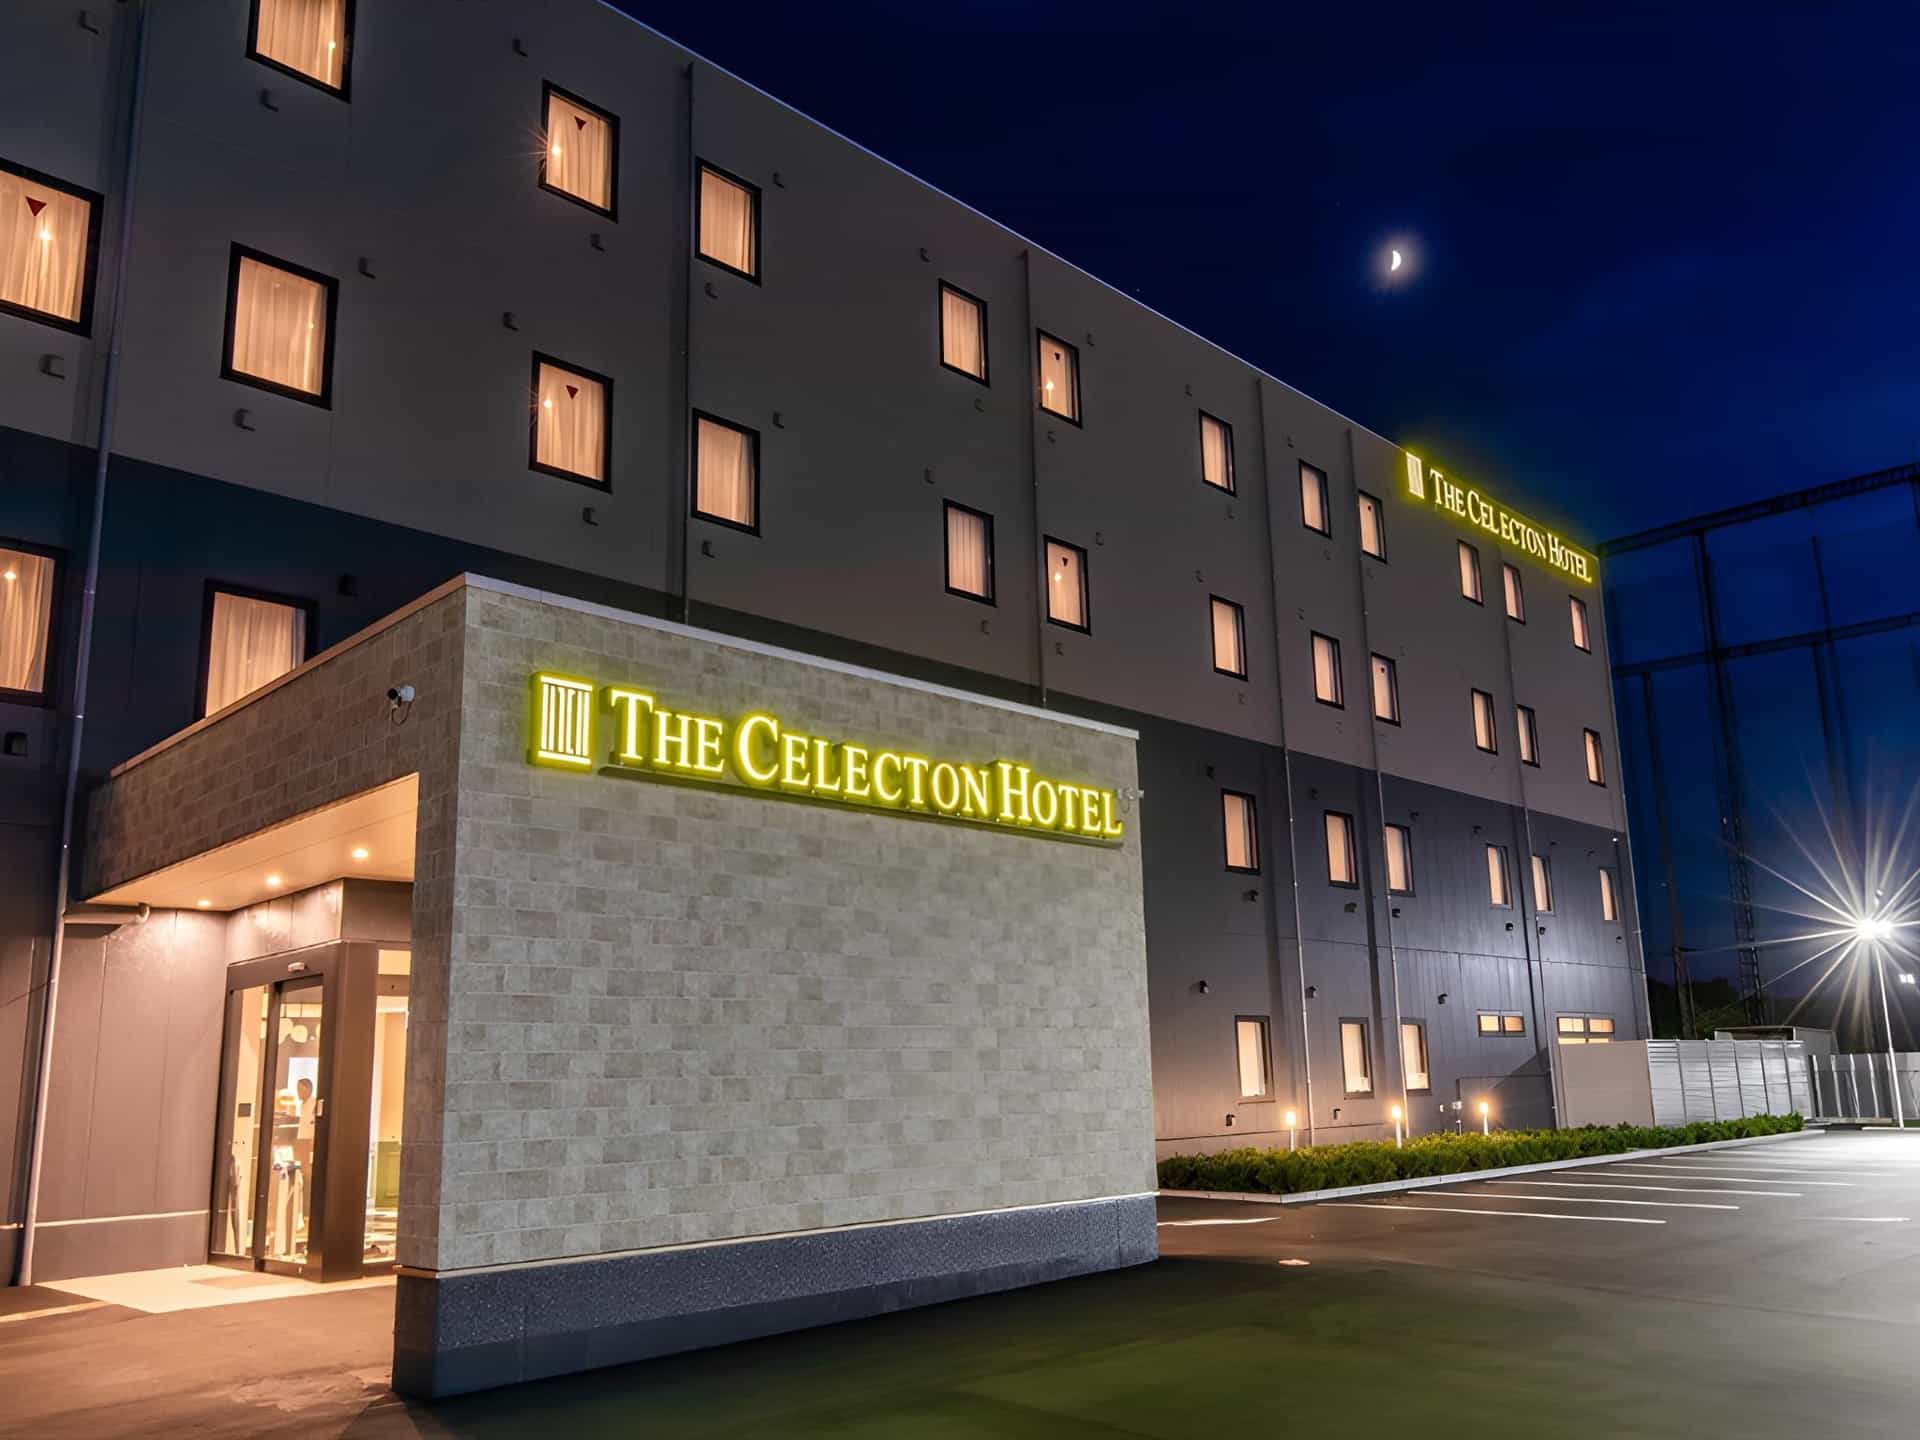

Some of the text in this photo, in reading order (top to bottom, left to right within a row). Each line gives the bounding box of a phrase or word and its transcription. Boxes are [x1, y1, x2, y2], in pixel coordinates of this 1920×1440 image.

[1429, 468, 1593, 583] THE CELECTON HOTEL
[610, 687, 1123, 837] THE CELECTON HOTEL
